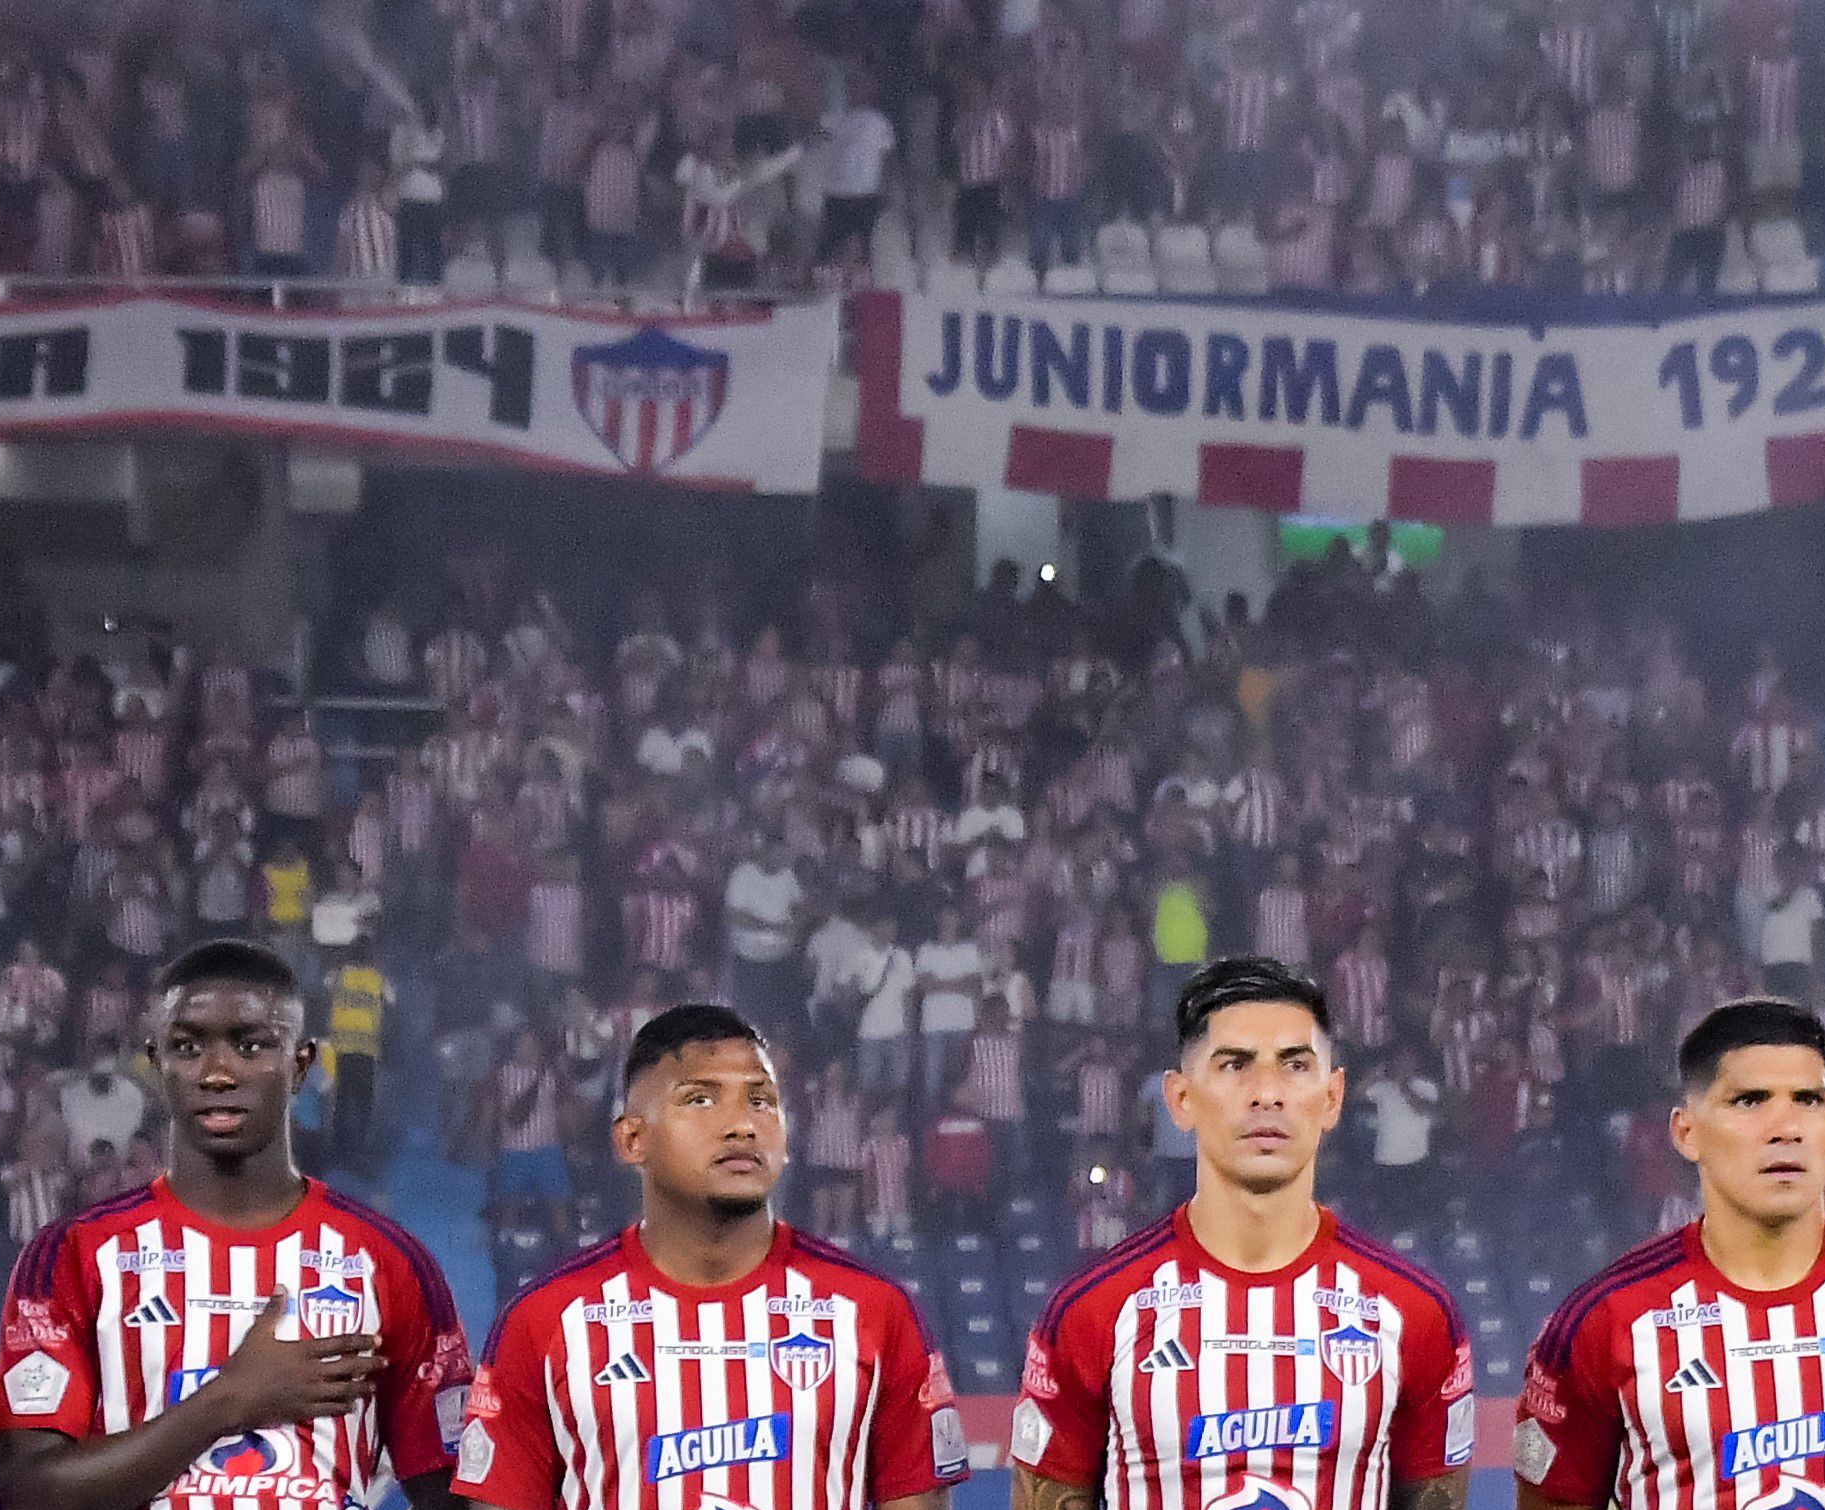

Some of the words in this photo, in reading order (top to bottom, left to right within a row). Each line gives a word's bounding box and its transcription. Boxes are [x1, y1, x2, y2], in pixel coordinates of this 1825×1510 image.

[176, 323, 534, 431] 1924
[925, 310, 1588, 441] JUNIORMANIA
[655, 1416, 778, 1480] AGUILA
[1197, 1404, 1322, 1457] AGUILA
